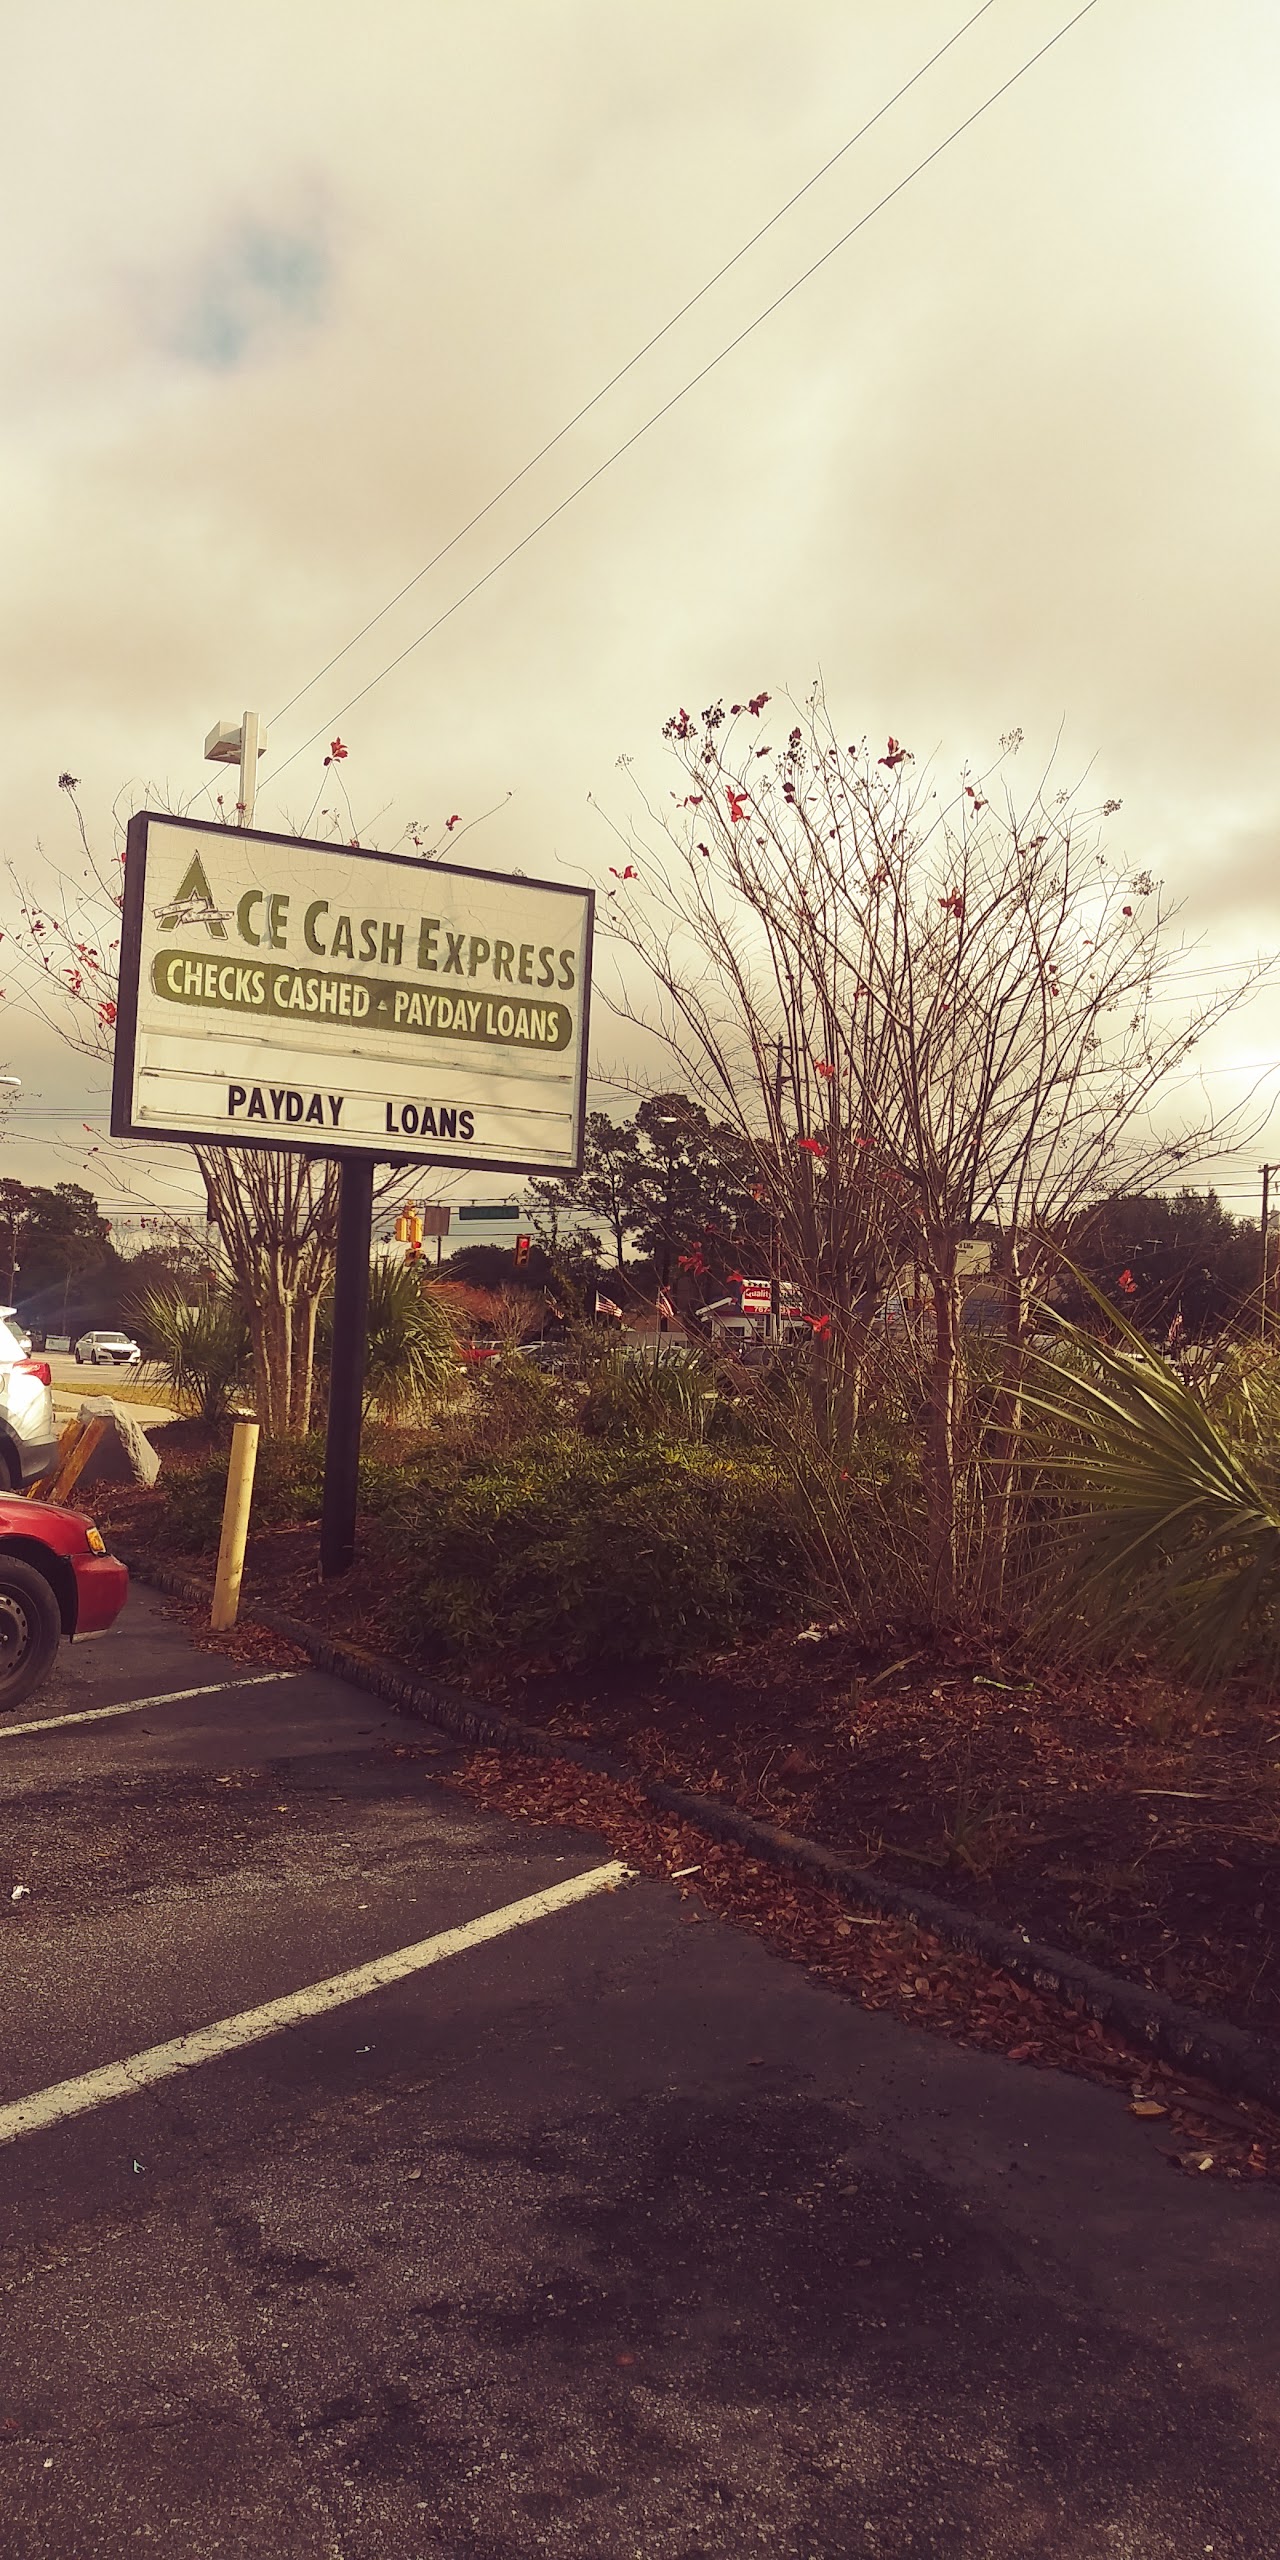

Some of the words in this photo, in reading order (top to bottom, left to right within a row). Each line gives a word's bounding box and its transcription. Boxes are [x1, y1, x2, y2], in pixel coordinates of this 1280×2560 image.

[153, 849, 290, 950] ACE
[304, 900, 404, 966] CASH
[417, 917, 575, 990] EXPRESS
[166, 958, 265, 1005] CHECKS
[273, 974, 370, 1019] CASHED
[394, 990, 481, 1033] PAYDAY
[487, 1003, 559, 1043] LOANS
[228, 1084, 344, 1126] PAYDAY
[386, 1102, 475, 1140] LOANS
